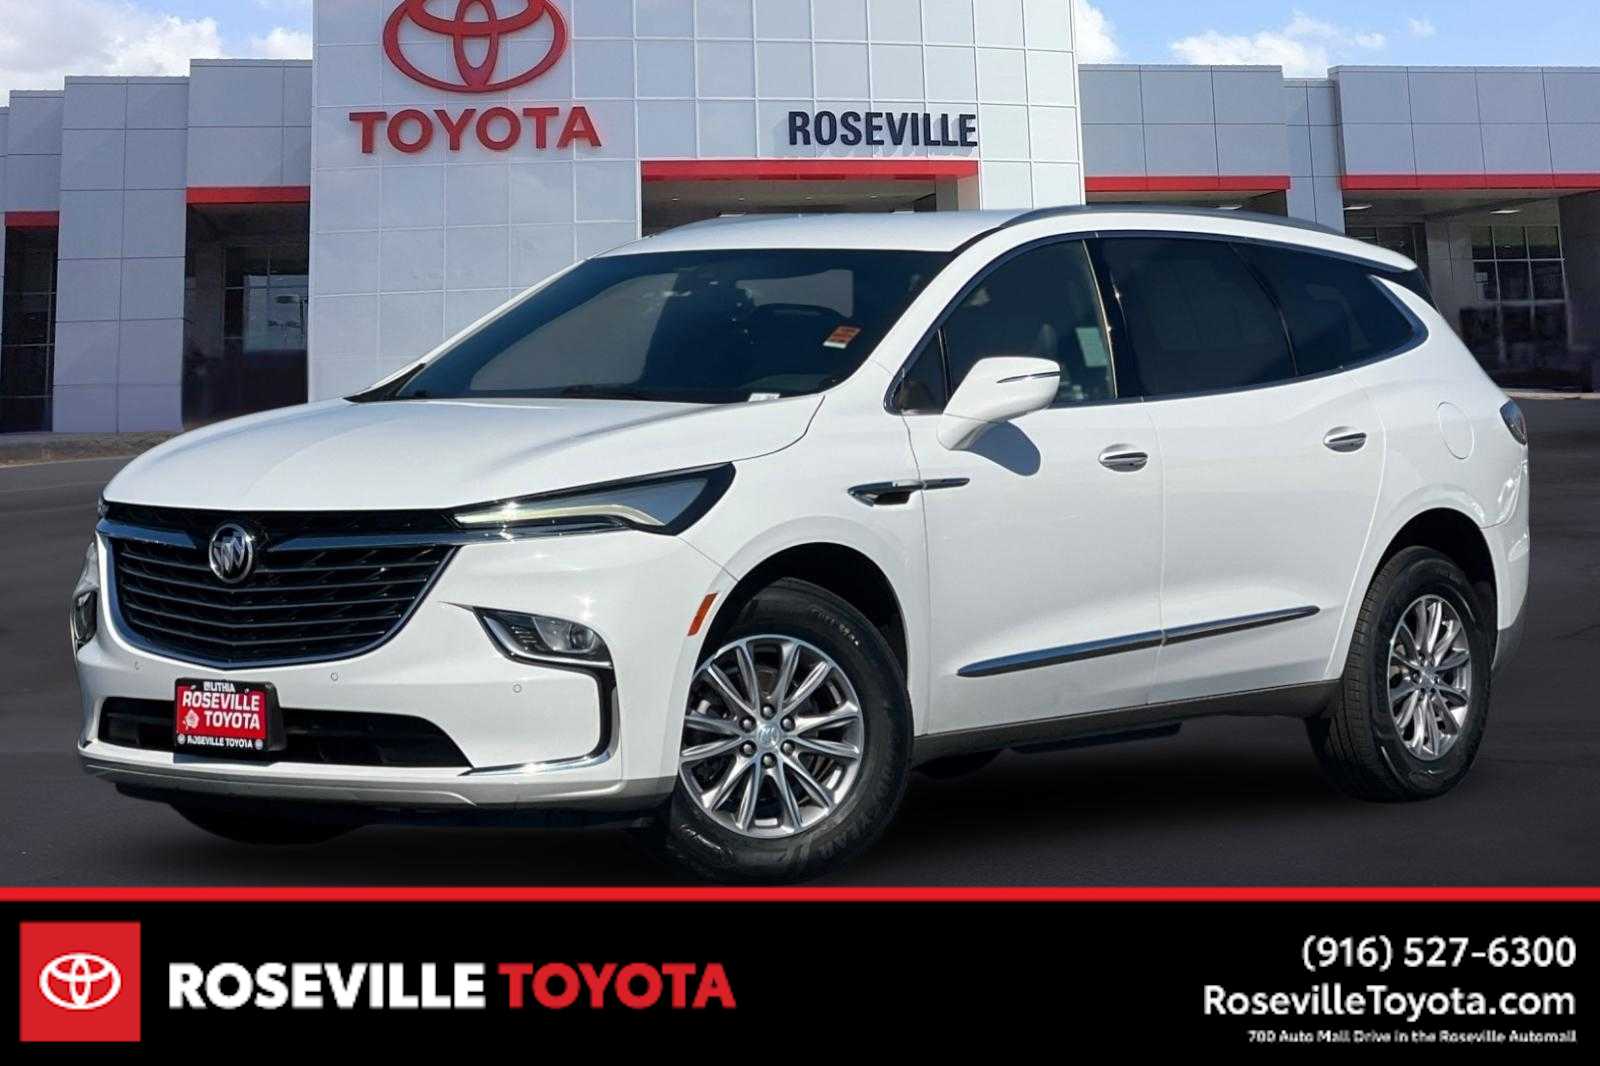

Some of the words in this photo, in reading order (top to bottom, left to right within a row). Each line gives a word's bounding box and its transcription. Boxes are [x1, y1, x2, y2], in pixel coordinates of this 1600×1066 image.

[349, 106, 602, 154] TOYOTA
[788, 111, 978, 147] ROSEVILLE
[182, 691, 260, 712] ROSEVILLE
[204, 711, 260, 730] TOYOTA
[187, 735, 224, 746] ROSEVILLE
[226, 738, 253, 749] TOYOTA
